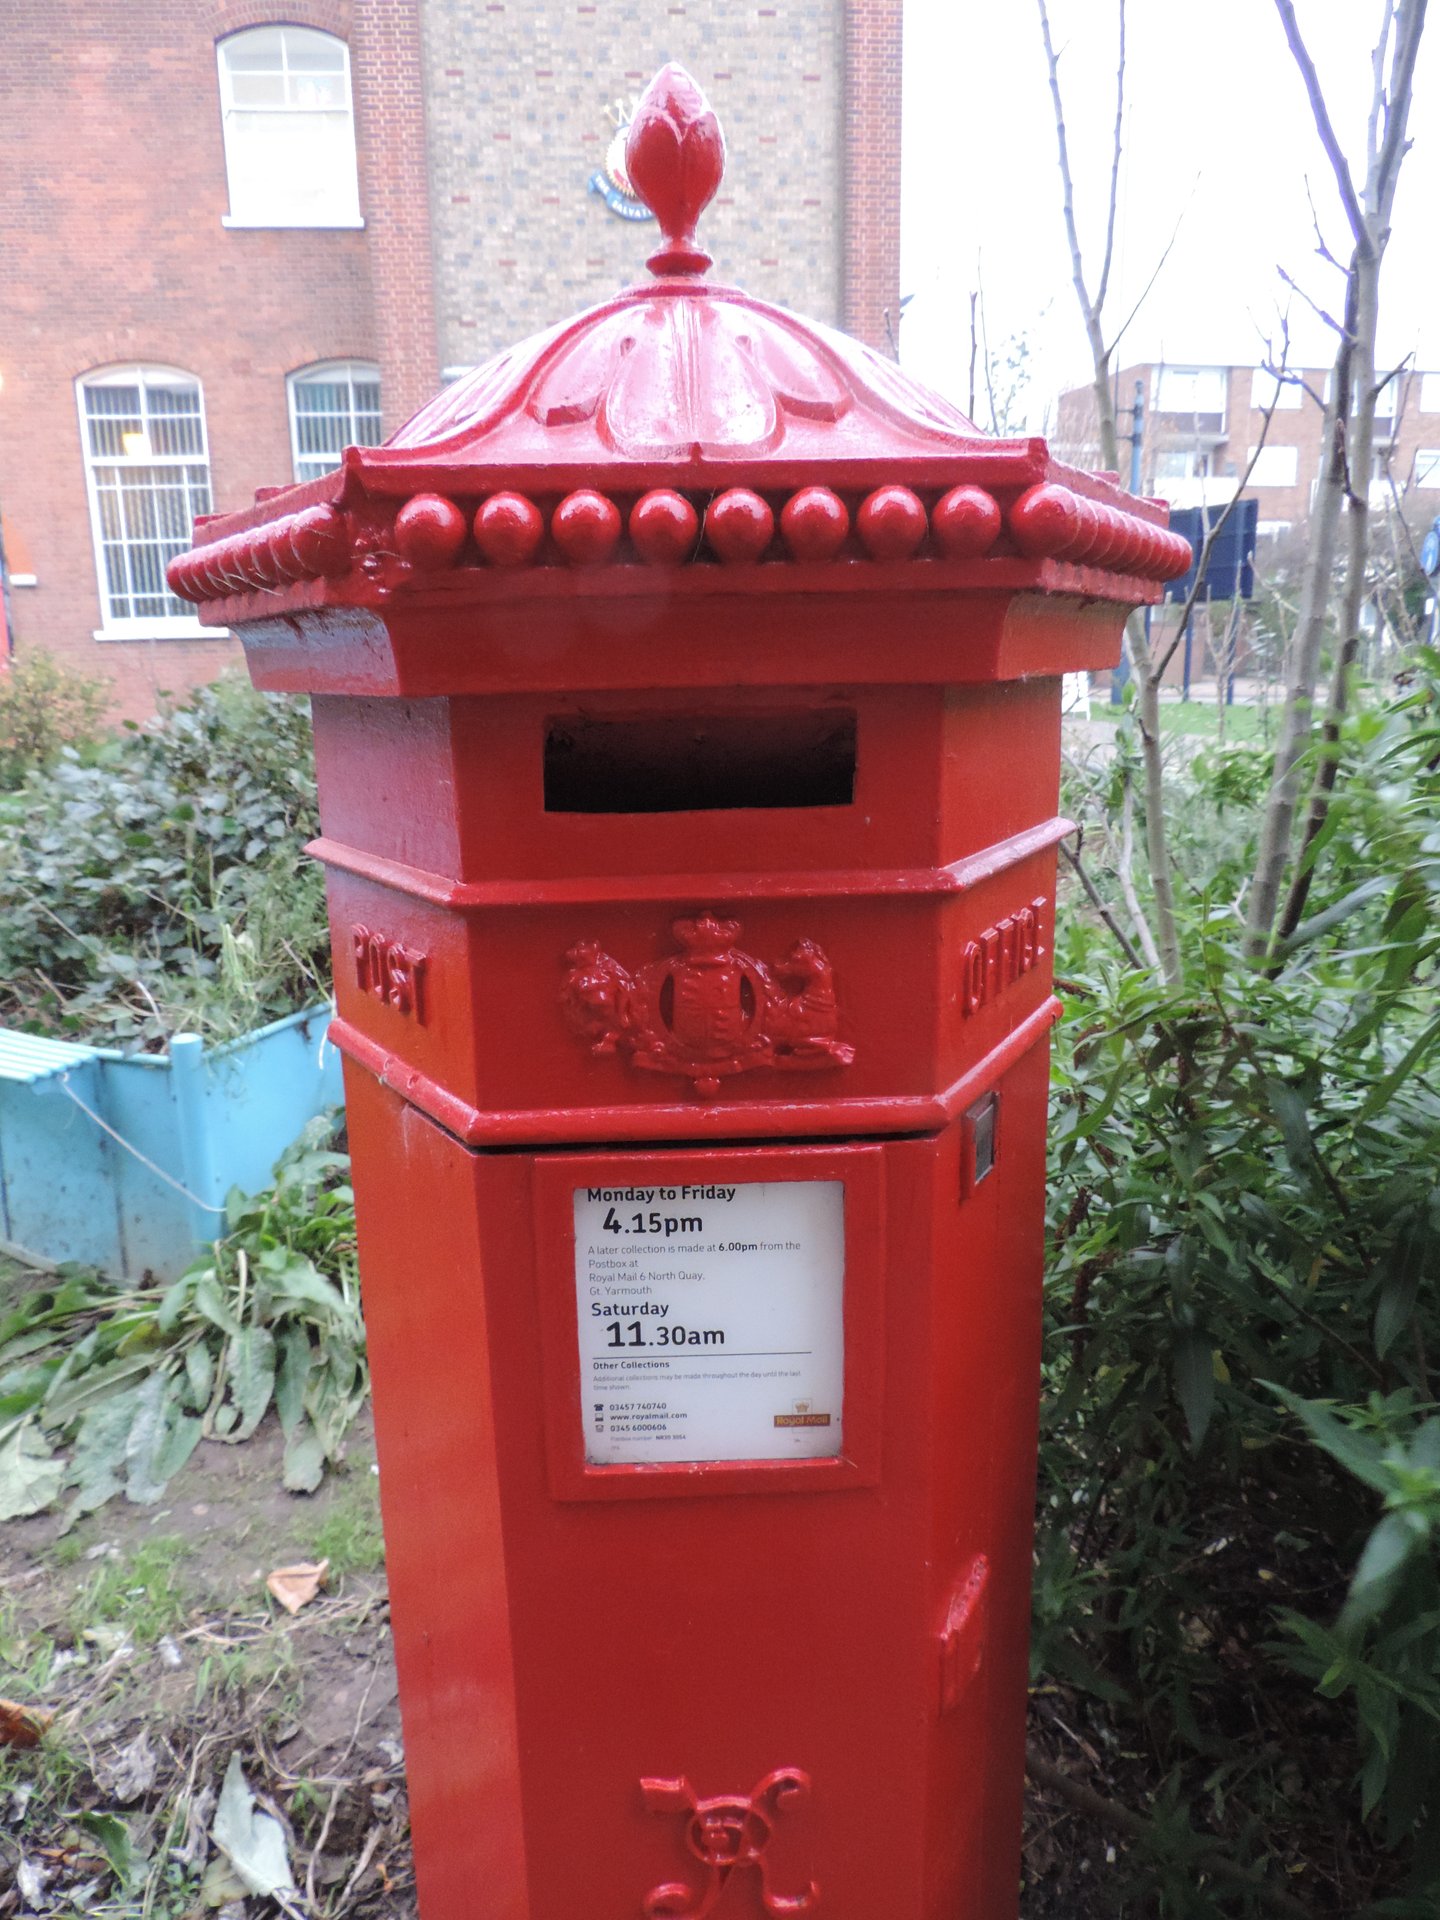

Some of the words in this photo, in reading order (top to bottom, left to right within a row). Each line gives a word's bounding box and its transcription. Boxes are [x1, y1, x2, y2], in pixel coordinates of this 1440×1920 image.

[963, 896, 1048, 1016] OFFICE
[351, 923, 428, 1030] POST
[587, 1187, 655, 1204] Monday
[659, 1187, 677, 1201] to
[681, 1185, 736, 1201] Friday
[602, 1207, 703, 1237] 4.15pm
[588, 1246, 595, 1255] A
[597, 1245, 618, 1255] later
[621, 1244, 666, 1254] collection
[668, 1244, 676, 1253] is
[678, 1243, 705, 1253] made
[707, 1244, 717, 1252] at
[718, 1242, 758, 1253] 6.00pm
[760, 1242, 784, 1251] from
[785, 1241, 801, 1250] the
[588, 1259, 627, 1269] Postbox
[629, 1260, 639, 1268] at
[589, 1274, 615, 1284] Royal
[617, 1272, 637, 1282] Mail
[639, 1272, 646, 1281] 6
[648, 1271, 676, 1281] North
[604, 1286, 653, 1296] Yarmouth
[591, 1302, 669, 1318] Saturday
[606, 1320, 725, 1348] 11.30am
[593, 1362, 619, 1370] Other
[621, 1361, 670, 1369] Collections
[702, 1372, 738, 1380] throughout
[750, 1371, 762, 1379] day
[609, 1403, 635, 1411] 03457
[637, 1402, 667, 1410] 740740
[610, 1412, 688, 1421] www.royalmail.com
[610, 1424, 630, 1432] 0345
[632, 1423, 667, 1432] 6000606
